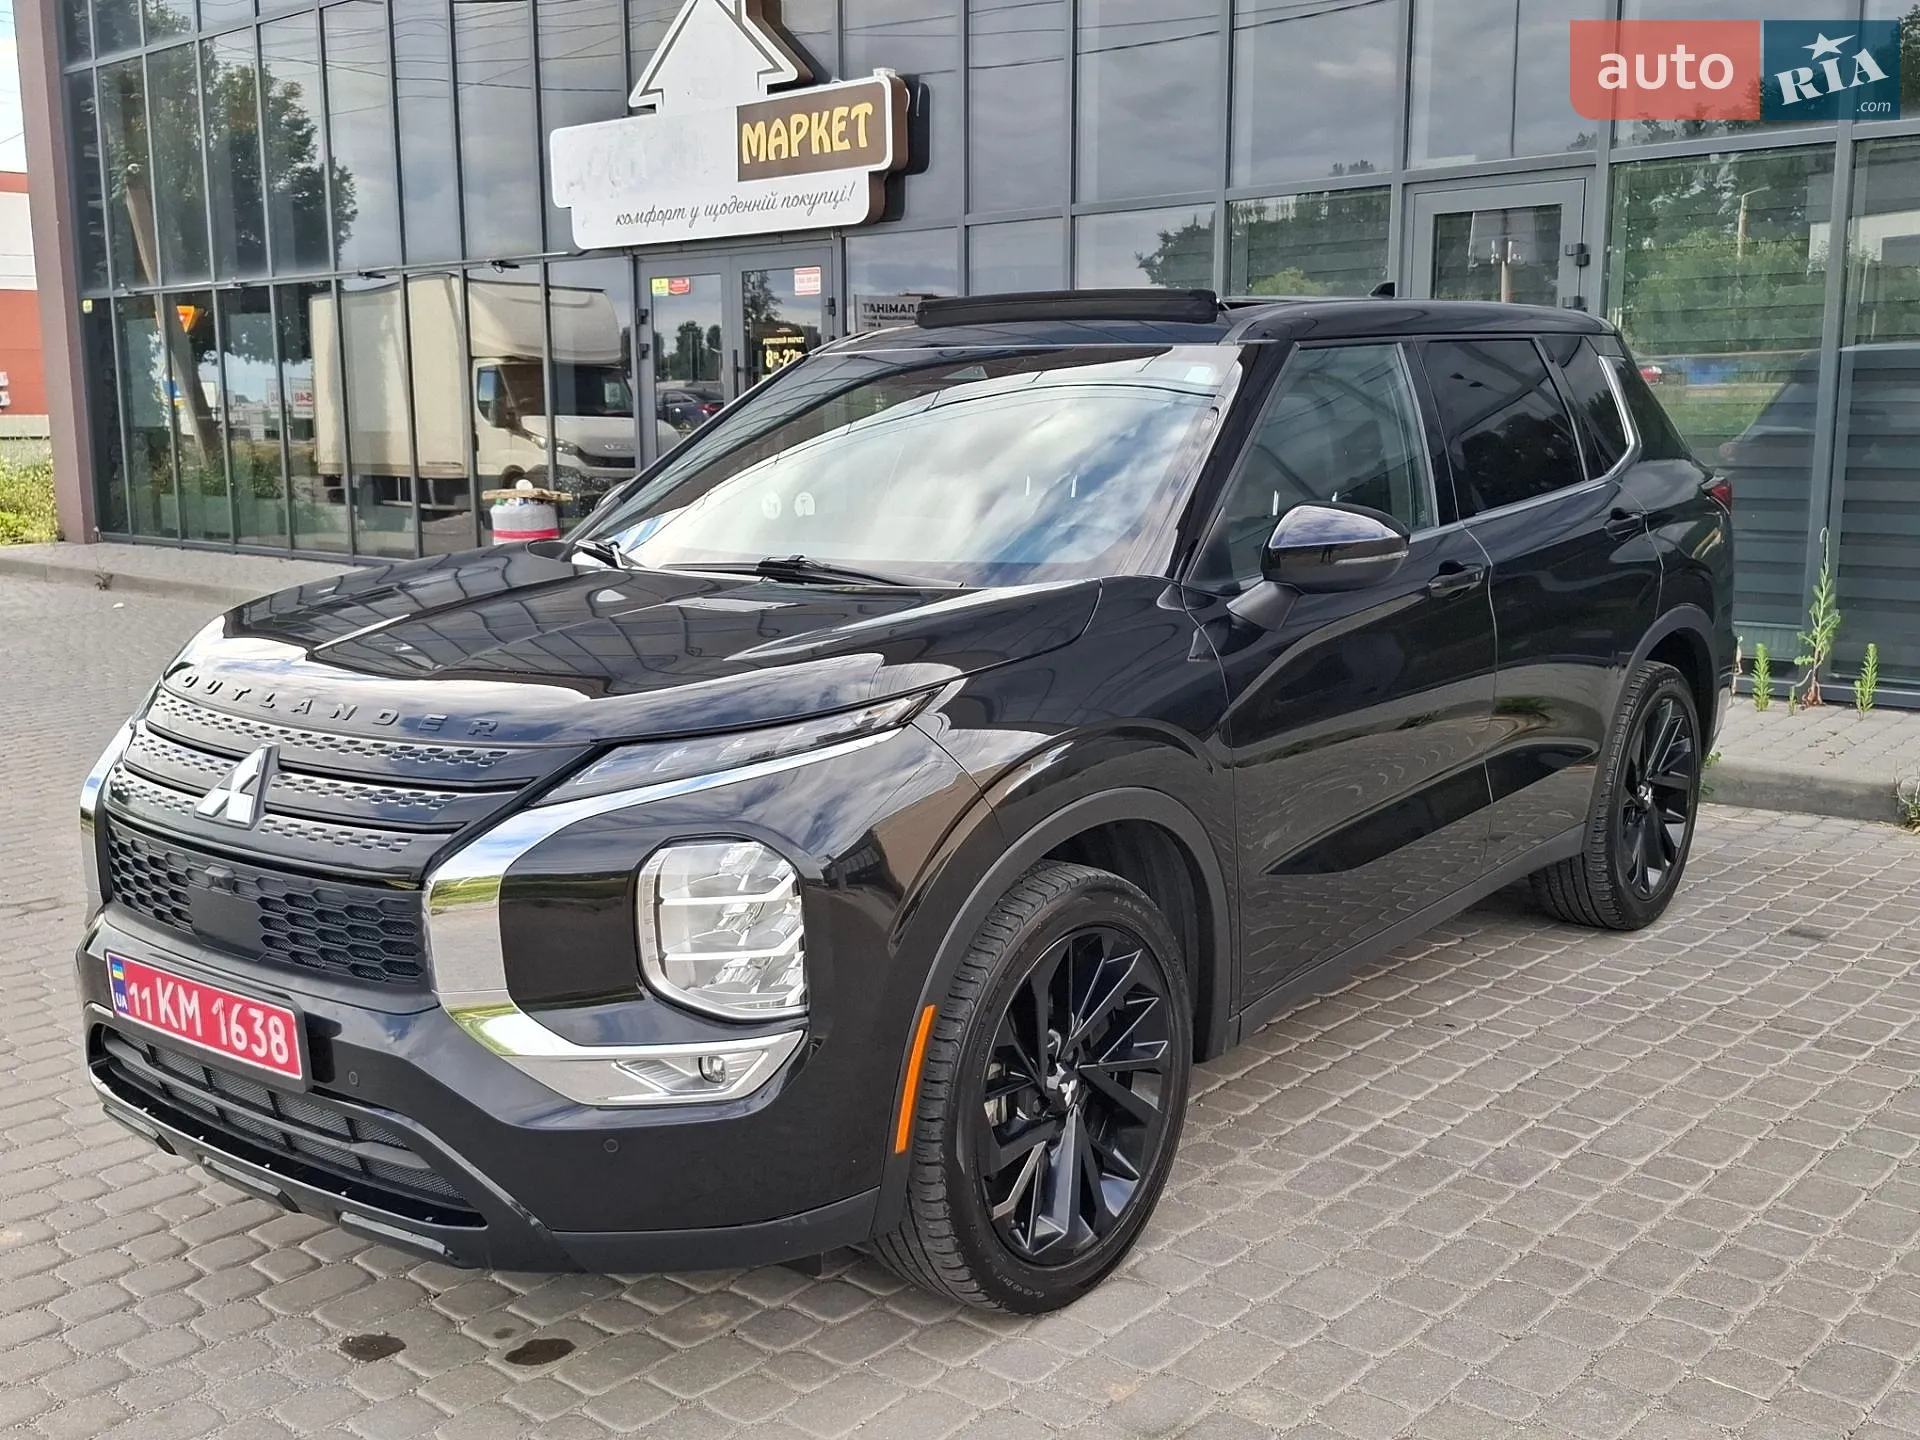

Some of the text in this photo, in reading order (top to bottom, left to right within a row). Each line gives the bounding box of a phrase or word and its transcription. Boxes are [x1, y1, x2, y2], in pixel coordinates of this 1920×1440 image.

[742, 102, 873, 164] МАРКЕТ
[616, 181, 856, 228] комфорт у щоденній покупці!
[183, 674, 498, 736] OUTLANDER
[115, 992, 128, 1010] UA
[211, 997, 289, 1065] 1638
